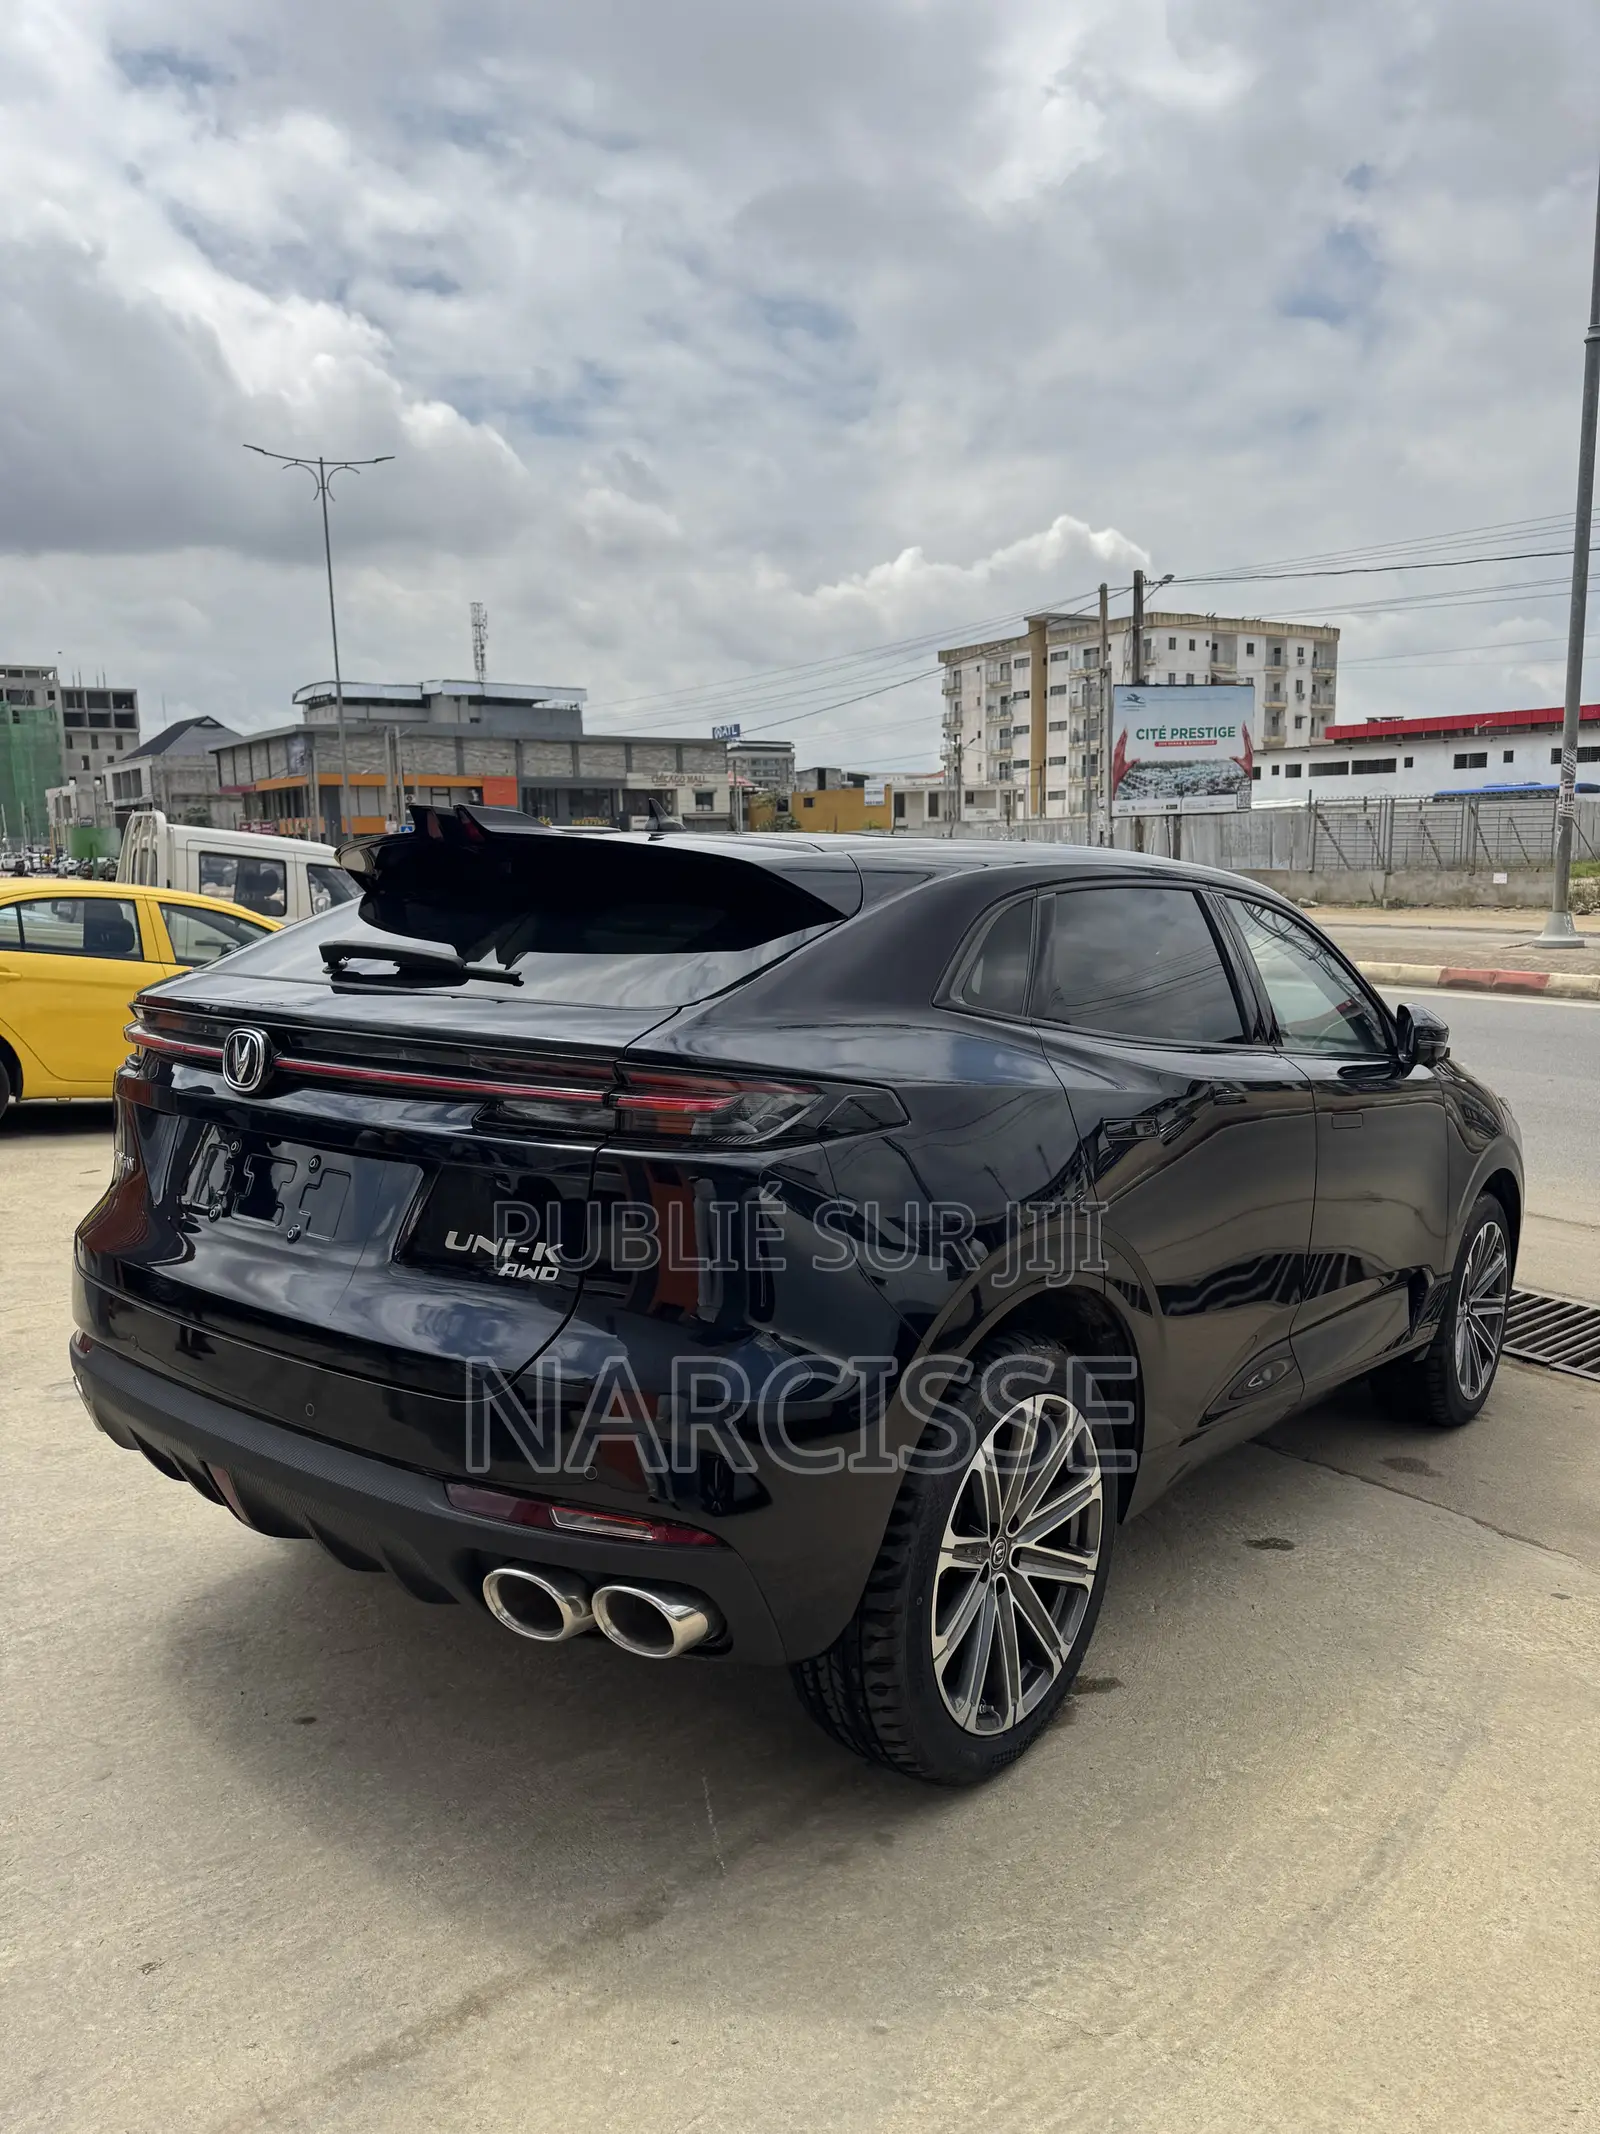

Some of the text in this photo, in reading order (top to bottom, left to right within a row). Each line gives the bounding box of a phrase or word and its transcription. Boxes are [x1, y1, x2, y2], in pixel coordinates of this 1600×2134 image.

[1136, 725, 1236, 740] CITÉ PRESTIGE
[444, 1230, 564, 1263] UNI-K
[498, 1262, 560, 1281] AWD
